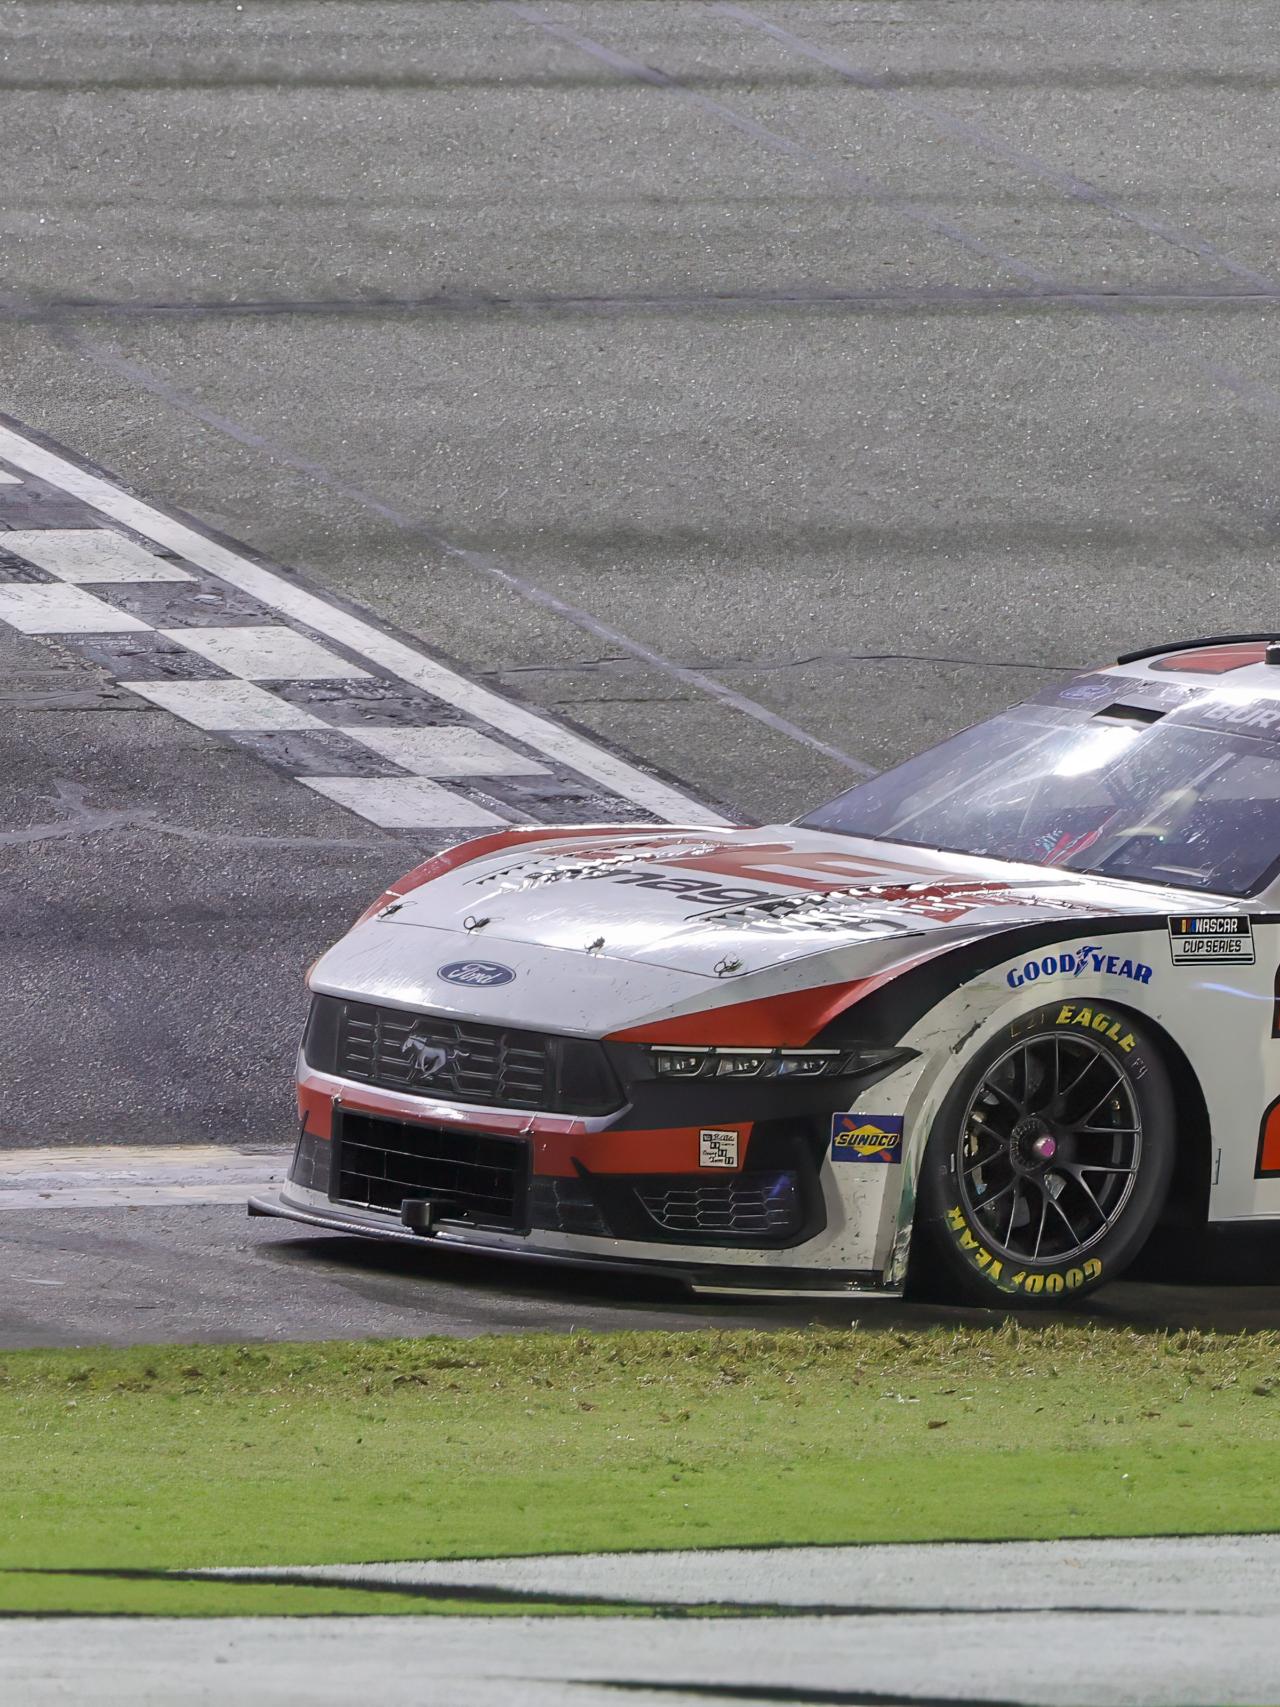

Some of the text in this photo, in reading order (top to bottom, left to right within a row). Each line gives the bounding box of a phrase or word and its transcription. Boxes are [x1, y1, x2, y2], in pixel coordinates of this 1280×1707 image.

[1195, 918, 1238, 933] NASCAR
[1183, 939, 1242, 954] CUP SERIES
[446, 963, 504, 984] Ford
[1056, 1005, 1138, 1052] EAGLE
[836, 1133, 899, 1147] SUNOCO
